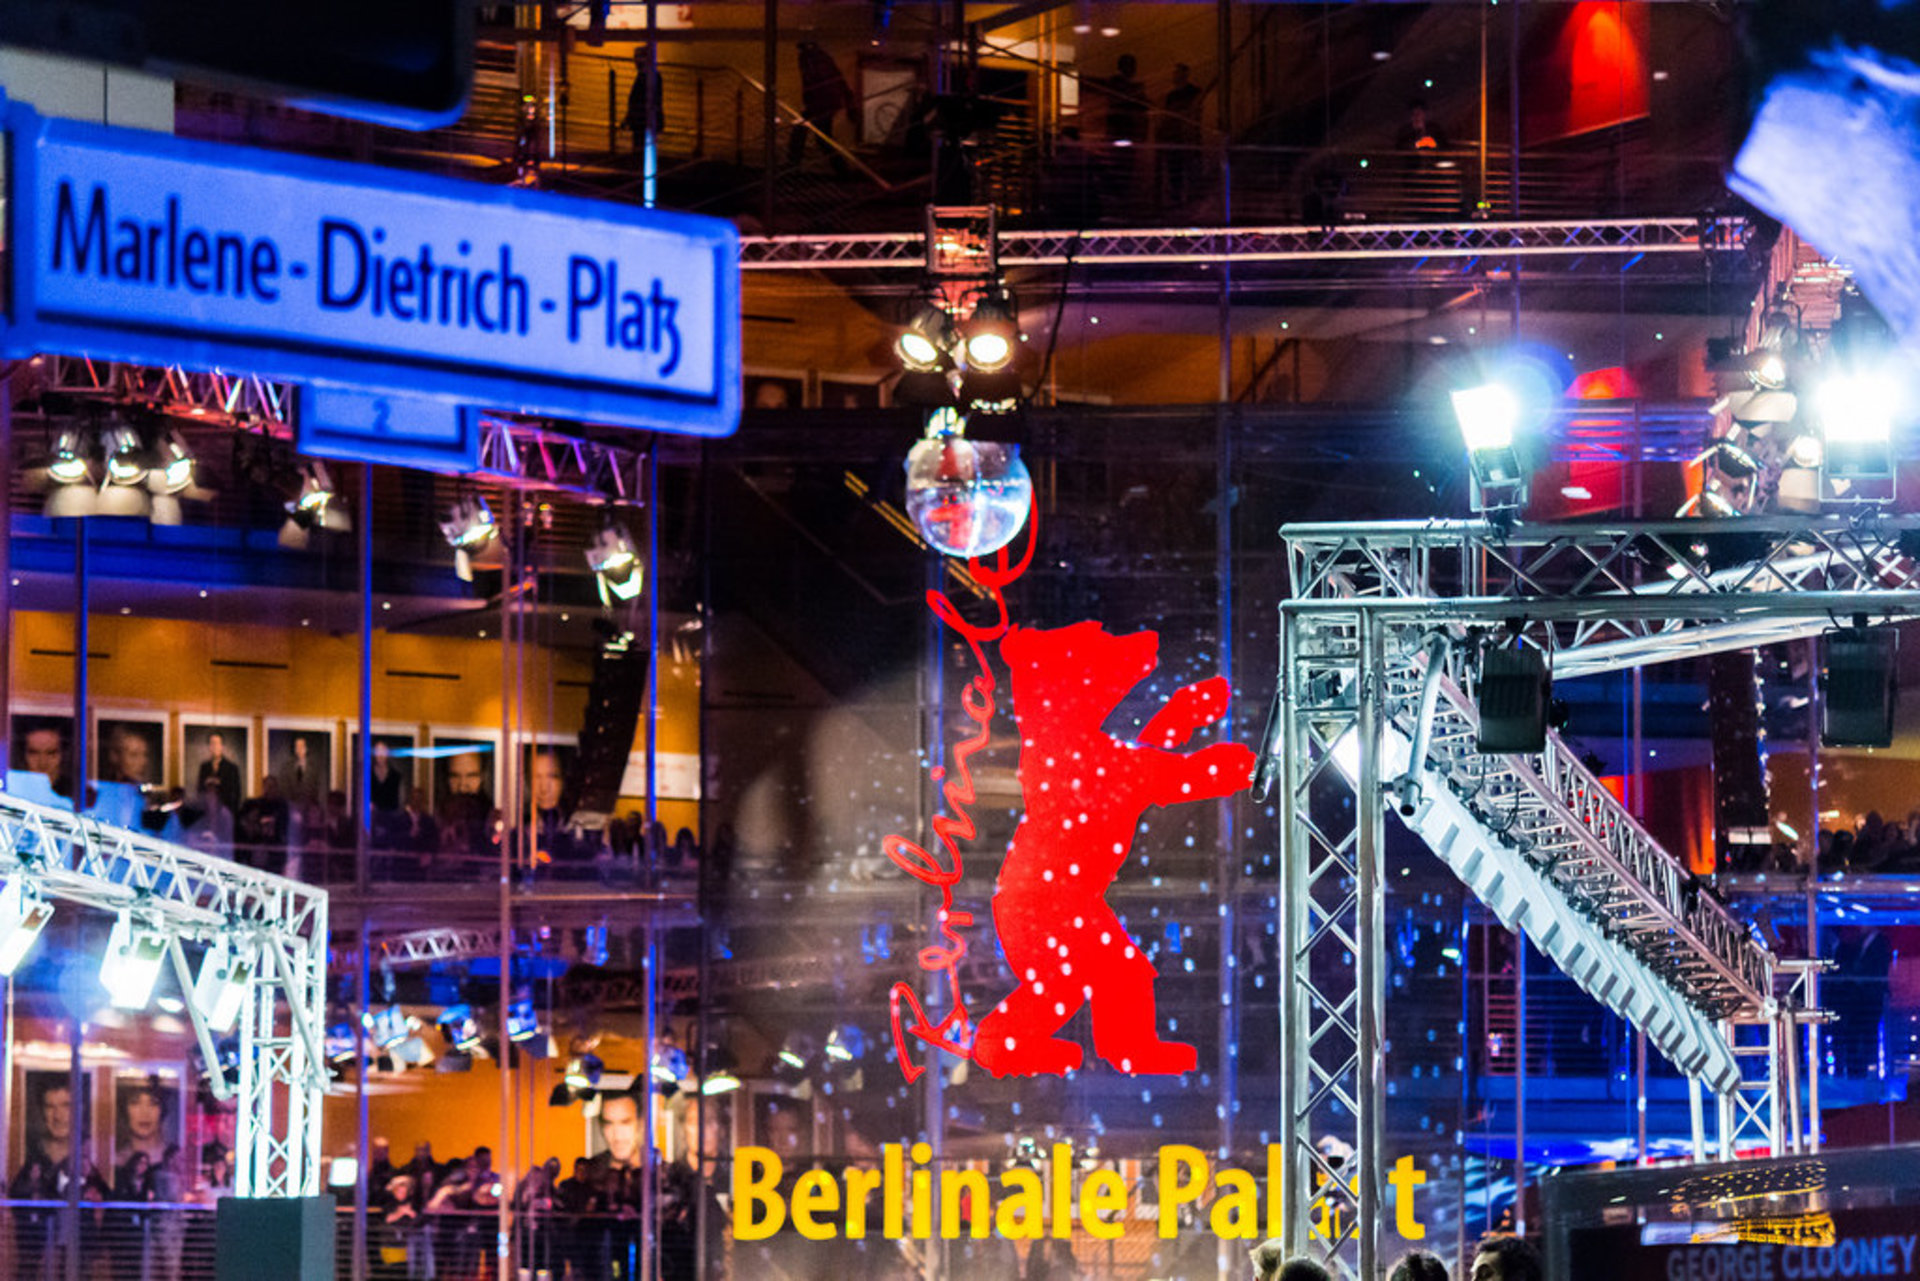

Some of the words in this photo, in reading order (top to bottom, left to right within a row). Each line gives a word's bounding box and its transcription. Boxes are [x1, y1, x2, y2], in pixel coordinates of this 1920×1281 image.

[732, 1142, 1127, 1240] Berlinale
[1158, 1143, 1427, 1240] Palt
[1667, 1246, 1774, 1281] GEORGE
[1782, 1235, 1917, 1277] CLOONEY
